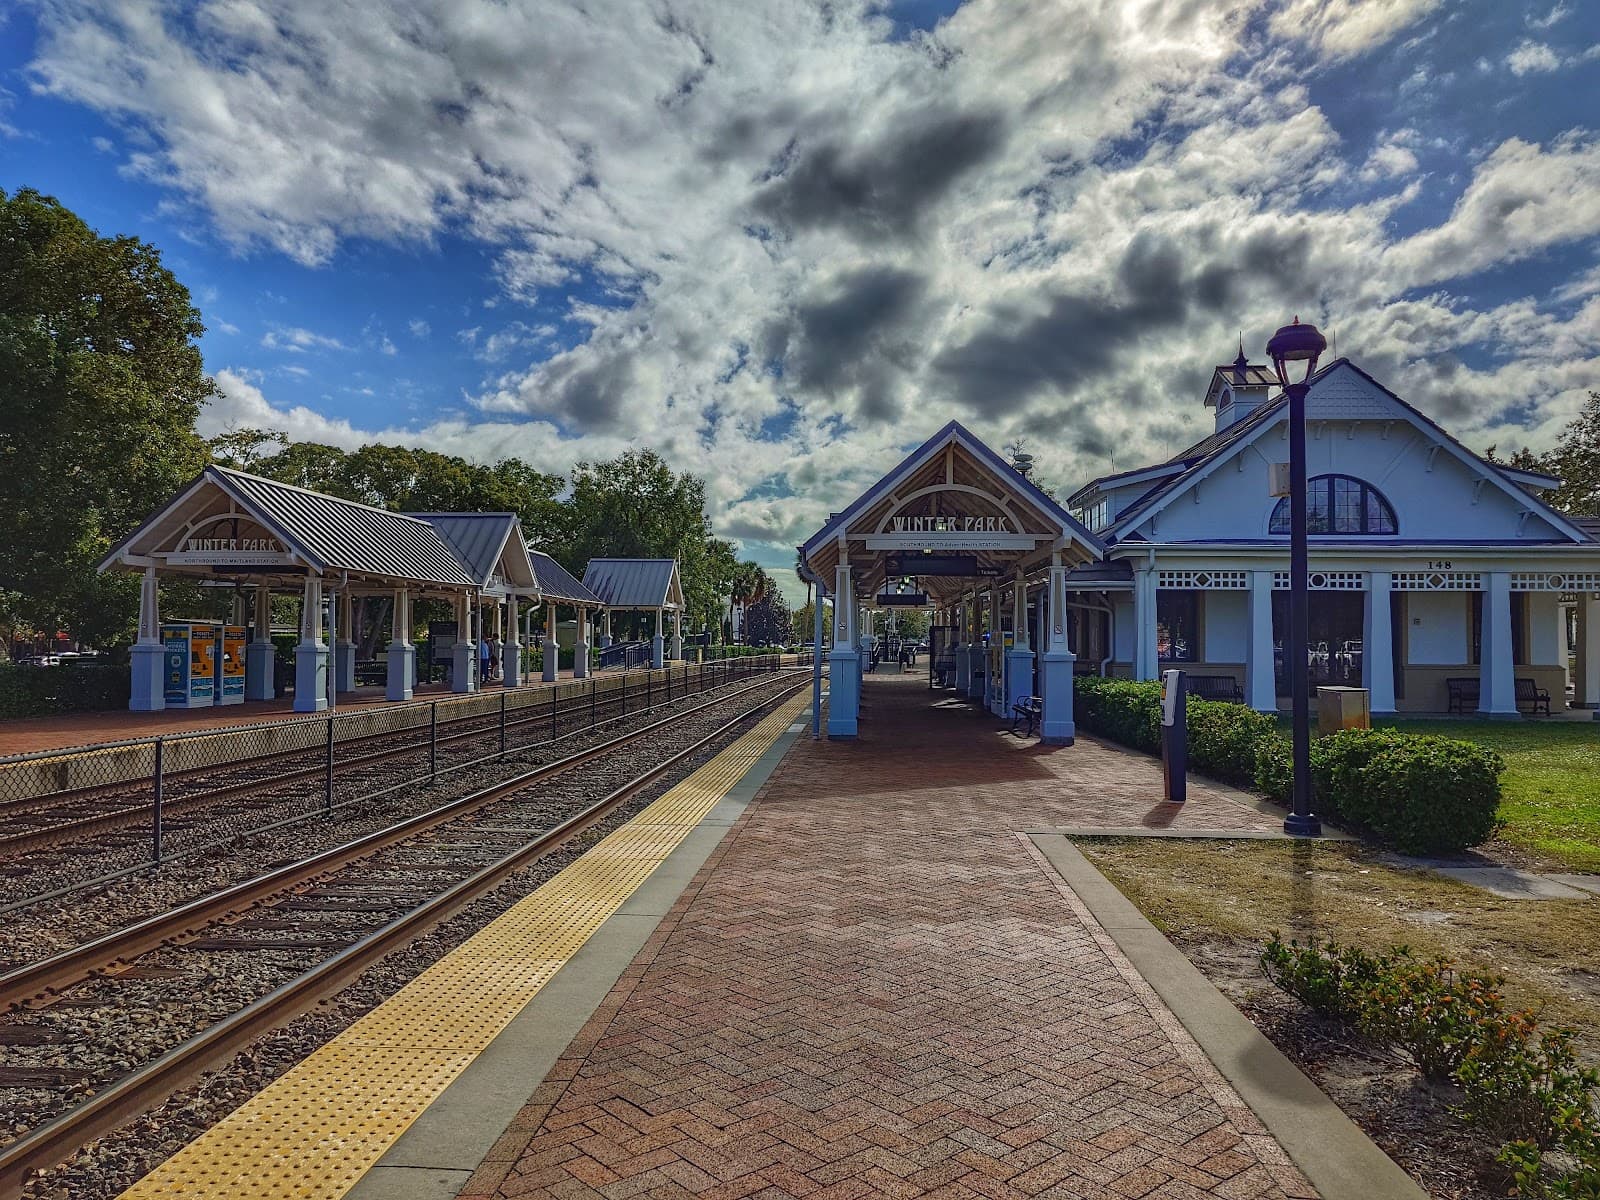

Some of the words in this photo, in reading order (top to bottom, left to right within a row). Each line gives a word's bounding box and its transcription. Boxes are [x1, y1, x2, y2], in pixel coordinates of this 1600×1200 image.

[893, 516, 957, 532] WINTER
[964, 516, 1008, 532] PARK
[188, 538, 237, 551] WINTER
[243, 538, 276, 552] PARK
[1427, 561, 1452, 570] 148
